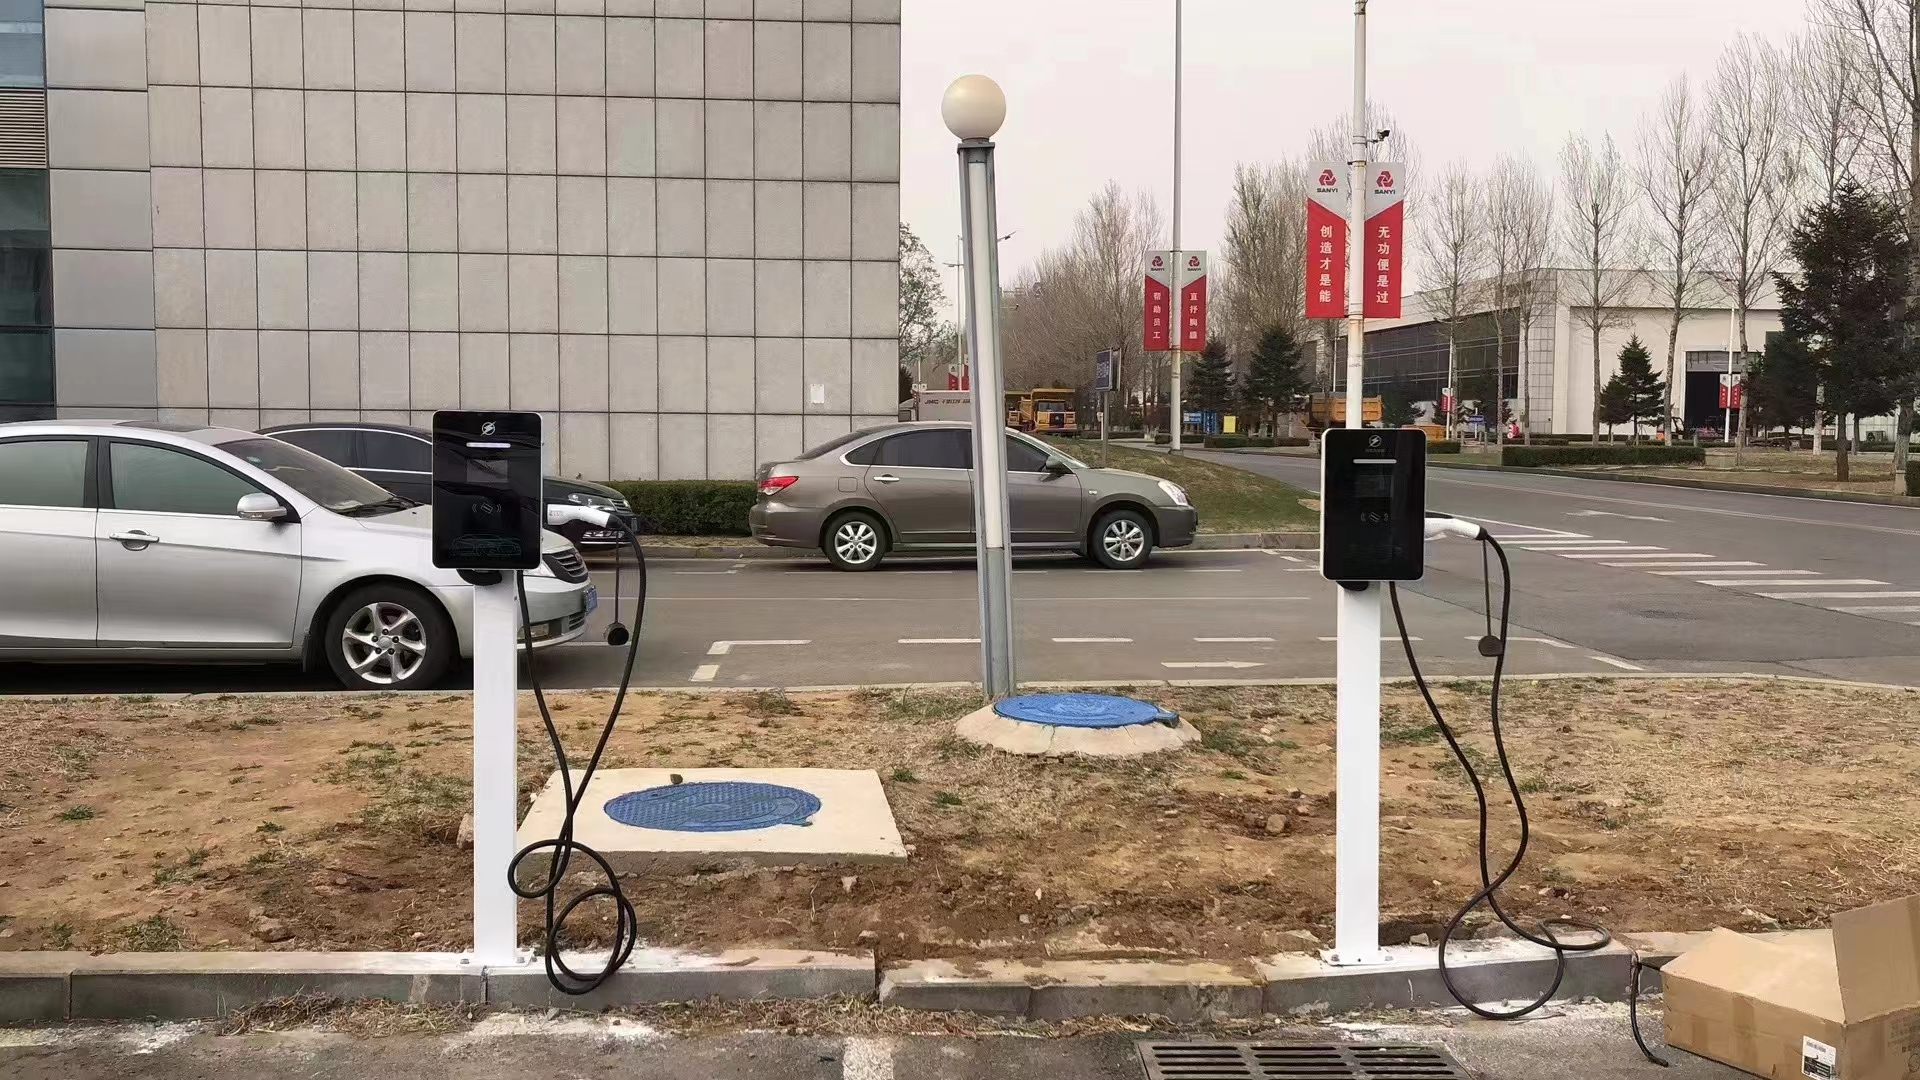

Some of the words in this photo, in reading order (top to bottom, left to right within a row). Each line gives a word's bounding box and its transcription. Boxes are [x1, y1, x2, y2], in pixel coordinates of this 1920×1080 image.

[1319, 225, 1332, 302] 创造才是能
[1376, 226, 1390, 304] 无功便是过
[1153, 292, 1161, 339] 帮助员工
